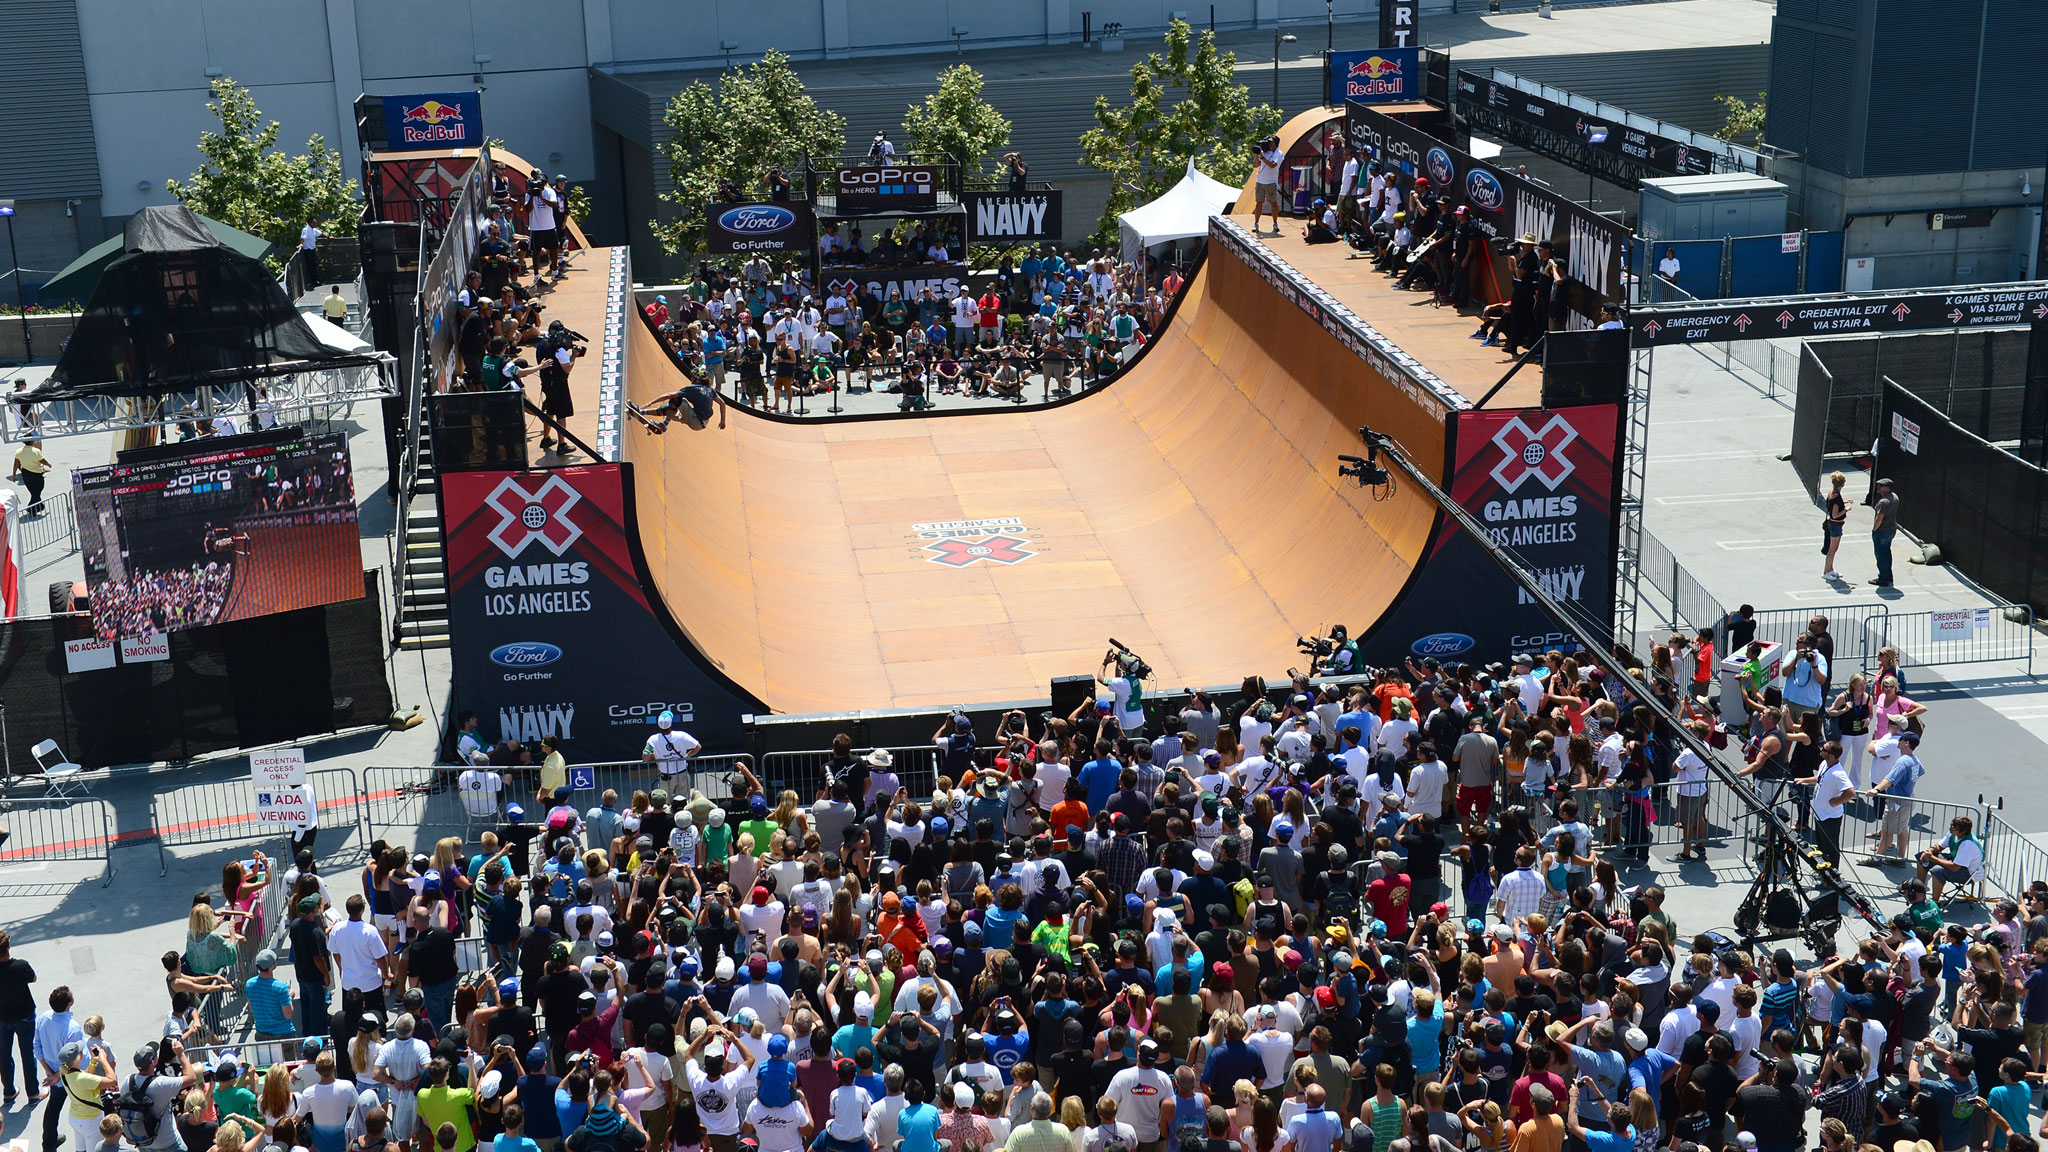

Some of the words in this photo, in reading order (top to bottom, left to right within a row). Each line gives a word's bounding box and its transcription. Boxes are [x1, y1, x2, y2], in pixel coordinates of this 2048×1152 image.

[1394, 0, 1412, 48] RT
[1347, 80, 1374, 96] Red
[1376, 78, 1402, 93] Bull
[404, 126, 435, 142] Red
[436, 124, 465, 140] Bull
[1350, 119, 1382, 146] GoPro
[1625, 131, 1629, 140] X
[1630, 132, 1645, 146] GAMES
[1387, 136, 1419, 165] GoPro
[1622, 143, 1637, 156] VENUE
[1638, 148, 1648, 159] EXIT
[840, 169, 931, 184] GoPro
[1472, 174, 1496, 204] Ford
[734, 208, 780, 228] Ford
[977, 204, 1047, 235] NAVY
[1478, 218, 1497, 237] Further
[732, 240, 747, 250] Go
[748, 239, 784, 249] Further
[1568, 225, 1612, 296] NAVY
[866, 278, 960, 301] GAMES
[1945, 297, 1953, 305] X
[1954, 294, 1990, 304] GAMES
[1993, 292, 2026, 302] VENUE
[2027, 291, 2048, 300] EXIT
[1800, 307, 1862, 319] CREDENTIAL
[1864, 304, 1888, 315] EXIT
[1988, 304, 2016, 312] STAIR
[1666, 315, 1731, 328] EMERGENCY
[1813, 321, 1829, 330] VIA
[1831, 319, 1860, 329] STAIR
[1863, 318, 1871, 327] A
[1984, 313, 2021, 322] RE-ENTRY)
[1686, 328, 1709, 338] EXIT
[1484, 496, 1577, 522] GAMES
[914, 520, 984, 531] ANGELES
[987, 518, 1020, 526] LOS
[920, 526, 1025, 539] GAMES
[1512, 522, 1576, 546] ANGELES
[484, 562, 589, 588] GAMES
[485, 594, 516, 616] LOS
[518, 591, 591, 614] ANGELES
[1934, 611, 1971, 621] CREDENTIAL
[1940, 621, 1964, 630] ACCESS
[68, 644, 79, 653] NO
[81, 642, 110, 651] ACCESS
[138, 636, 150, 645] NO
[1426, 637, 1462, 653] Ford
[124, 645, 167, 657] SMOKING
[504, 646, 547, 663] Ford
[519, 671, 552, 680] Further
[609, 702, 694, 717] GoPro
[500, 710, 574, 743] NAVY
[254, 757, 301, 765] CREDENTIAL
[275, 795, 302, 804] ADA
[260, 811, 306, 820] VIEWING
